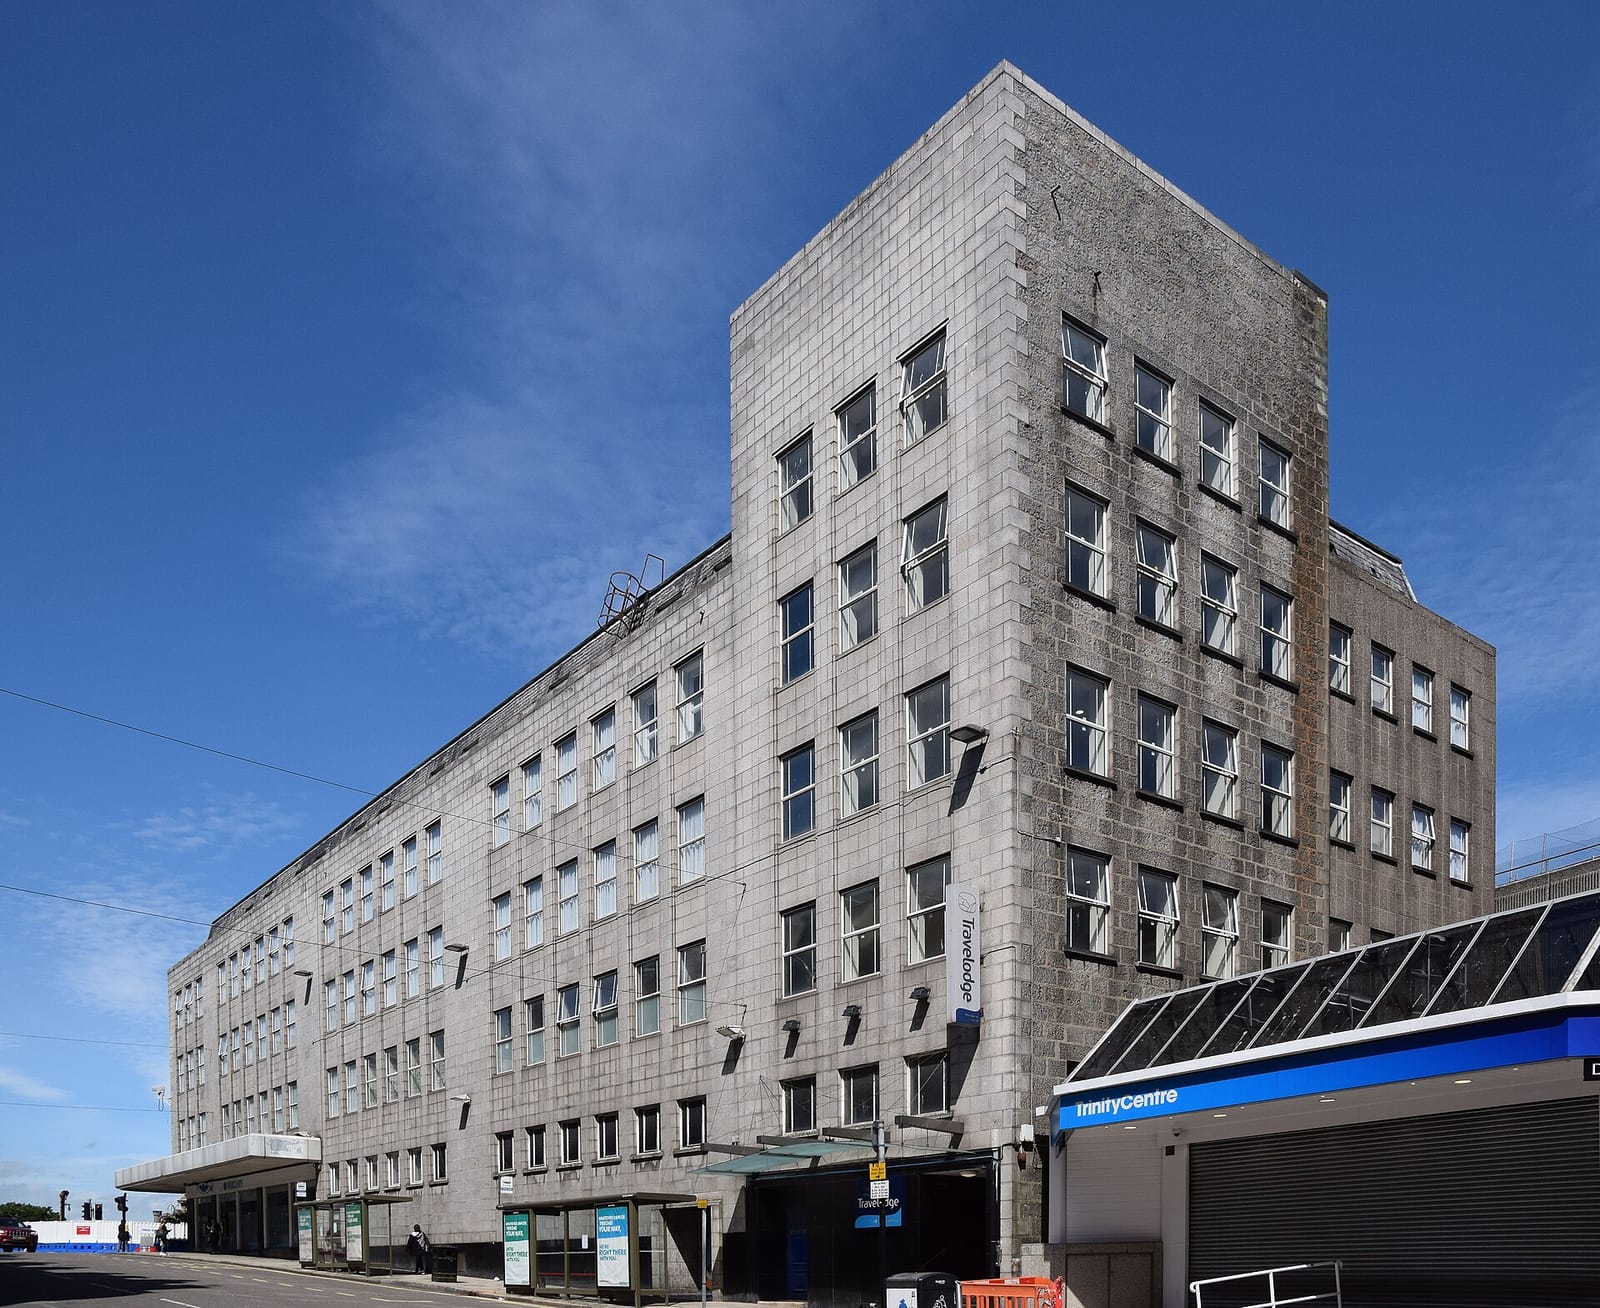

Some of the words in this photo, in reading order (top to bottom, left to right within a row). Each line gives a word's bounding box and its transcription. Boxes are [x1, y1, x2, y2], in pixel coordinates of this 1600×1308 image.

[960, 917, 975, 1003] Travelodge
[1076, 1088, 1178, 1117] TrinityCentre
[857, 1198, 900, 1209] Travelge
